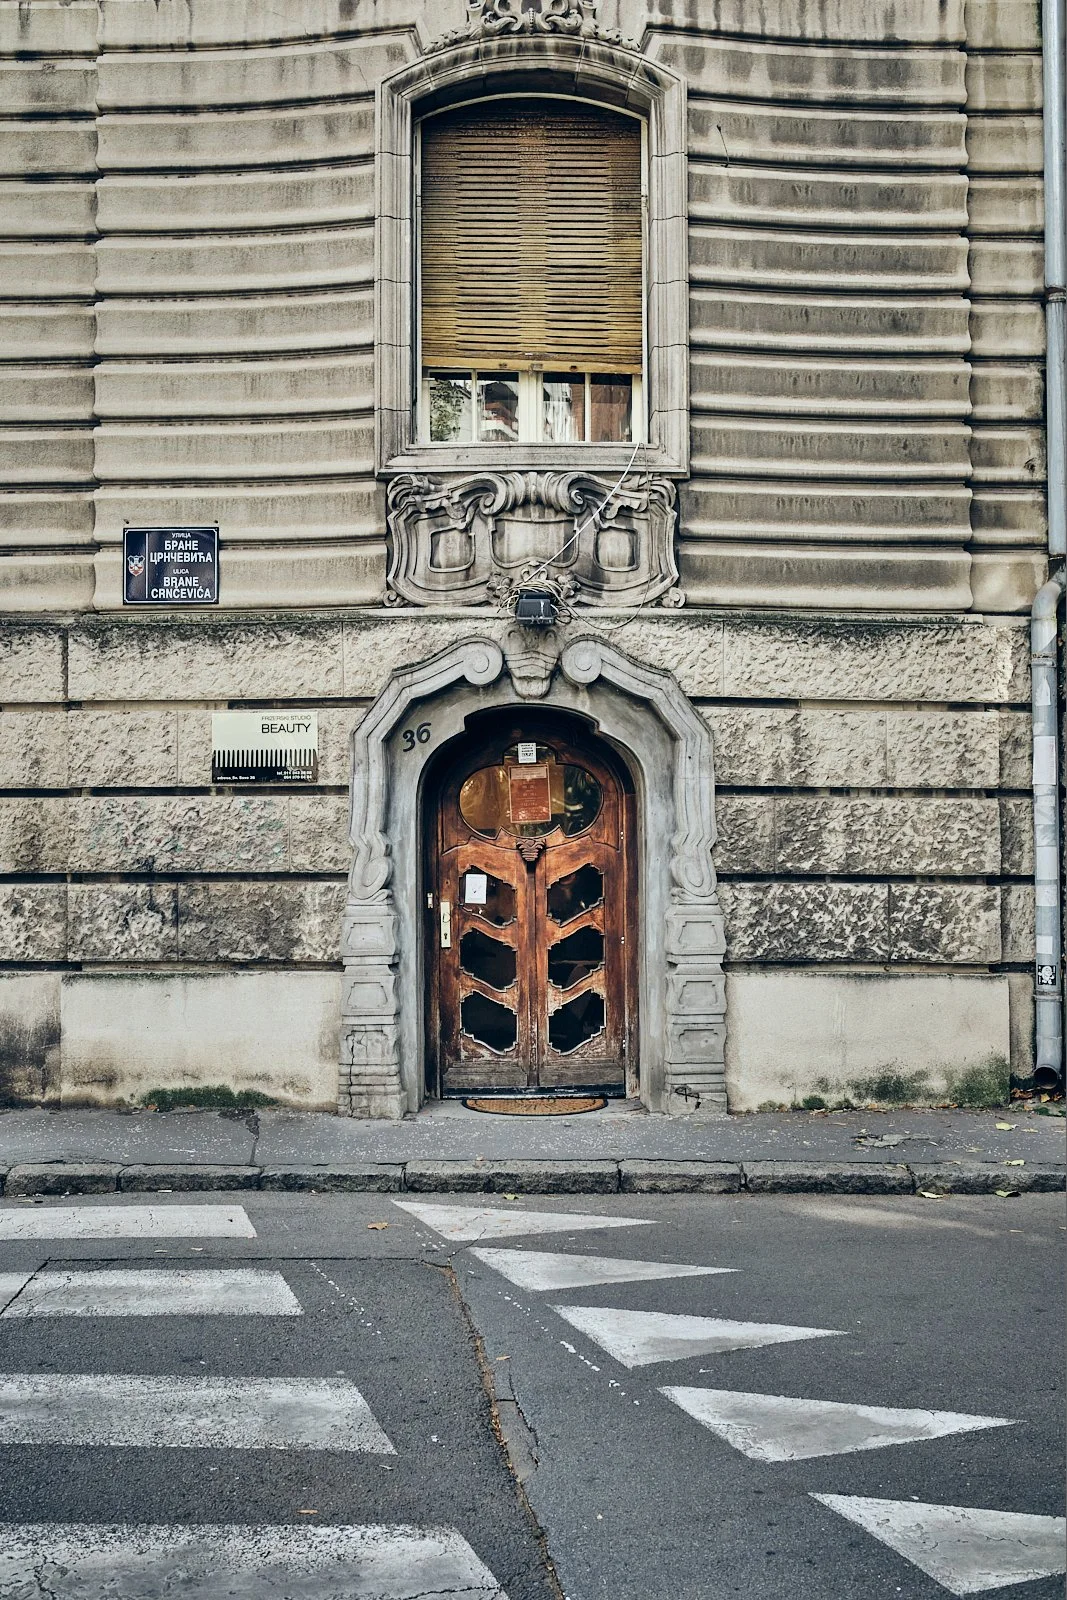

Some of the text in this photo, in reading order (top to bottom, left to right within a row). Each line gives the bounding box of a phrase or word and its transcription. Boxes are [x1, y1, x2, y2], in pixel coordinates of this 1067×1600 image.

[164, 540, 199, 550] БРАНЕ
[150, 552, 212, 565] ЦРНЧЕВИЋА
[164, 576, 199, 586] BRANE
[151, 586, 211, 598] CRNČEVIĆA
[261, 723, 311, 734] BEAUTY
[402, 722, 432, 752] 36
